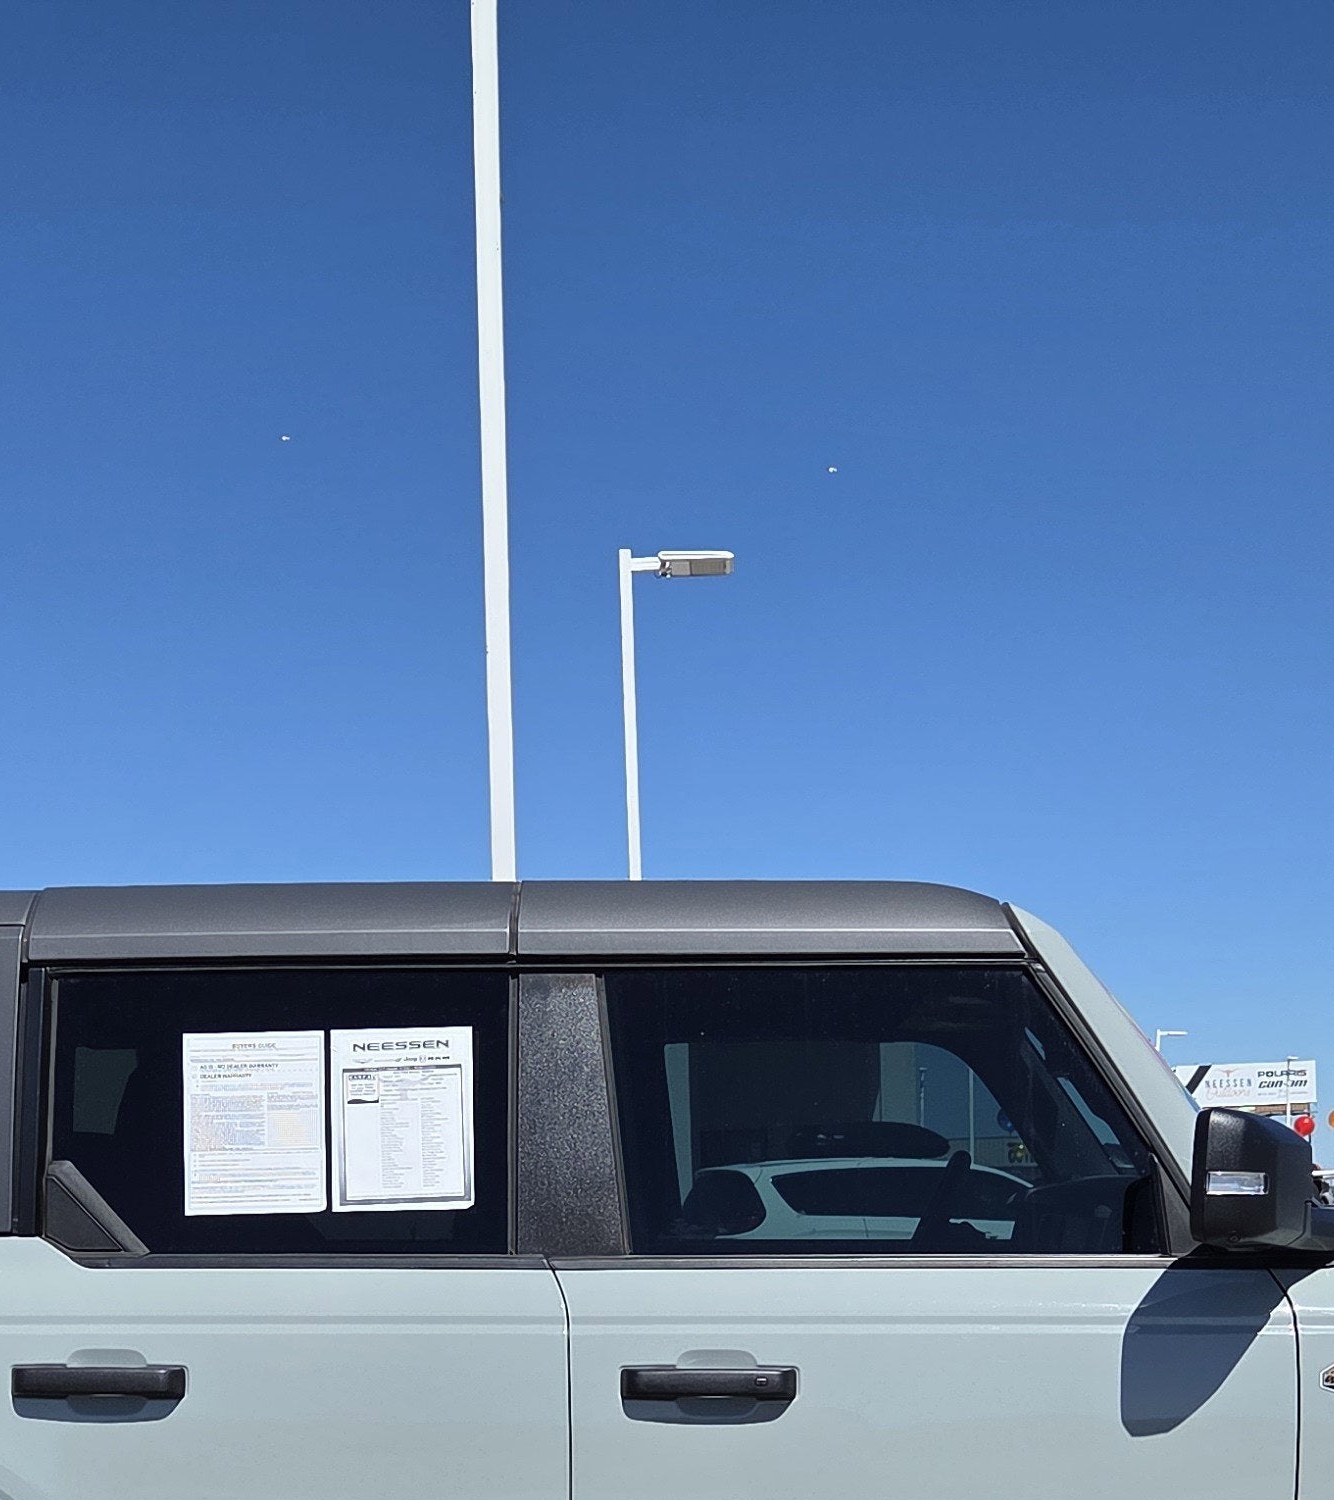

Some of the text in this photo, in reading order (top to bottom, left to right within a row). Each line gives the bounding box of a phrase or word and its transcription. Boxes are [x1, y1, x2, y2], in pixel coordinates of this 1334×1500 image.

[353, 1039, 449, 1052] NEESSEN
[1257, 1069, 1307, 1078] POLARIS
[1205, 1078, 1252, 1089] NEESSEN
